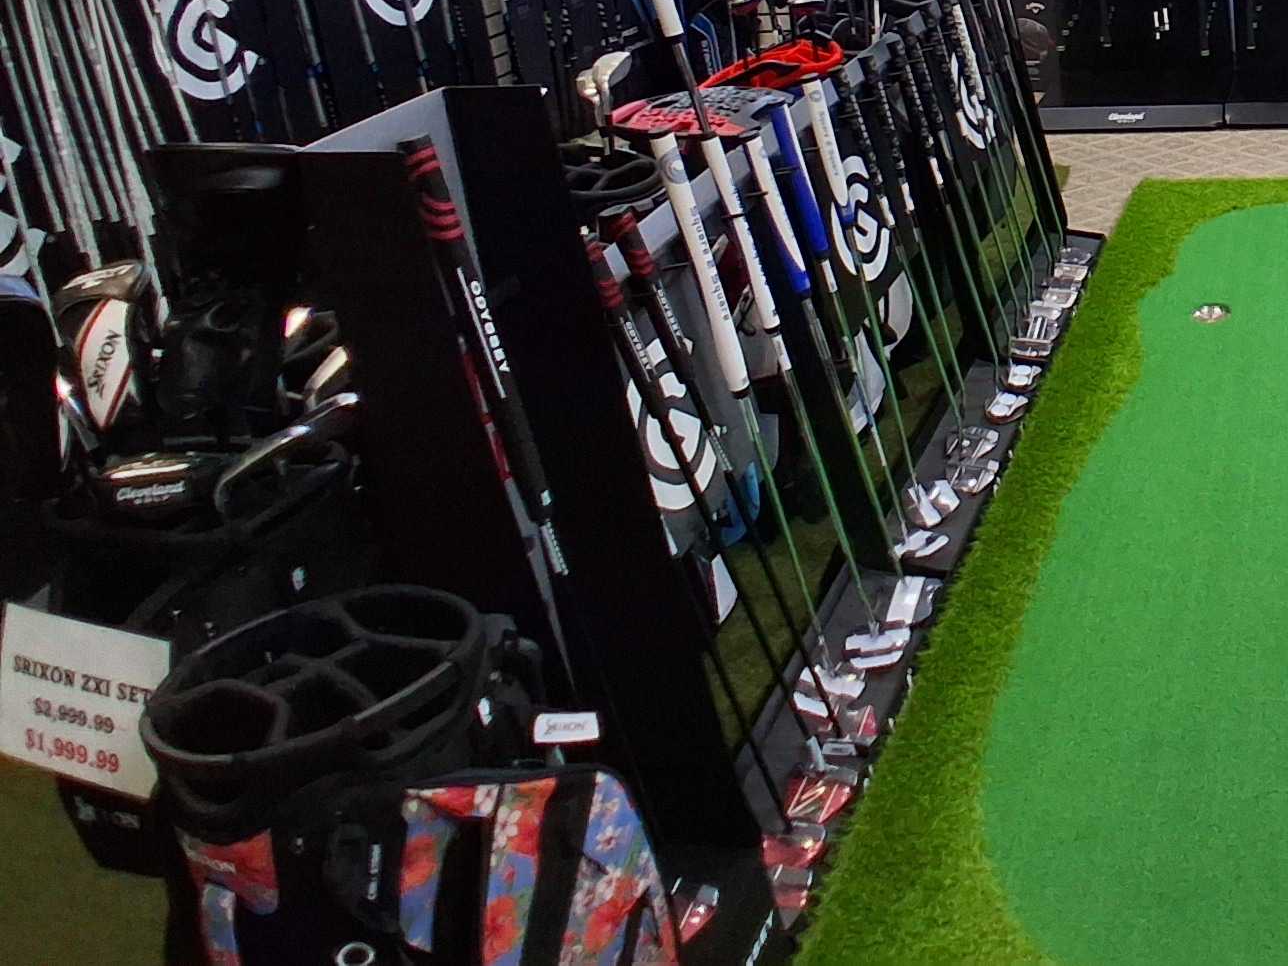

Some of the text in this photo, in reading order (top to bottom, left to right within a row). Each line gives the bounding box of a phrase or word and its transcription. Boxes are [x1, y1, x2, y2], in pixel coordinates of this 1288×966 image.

[470, 280, 511, 372] ODYSSEY
[13, 654, 153, 705] SRIXON ZXI SET
[25, 727, 120, 774] $1,999.99
